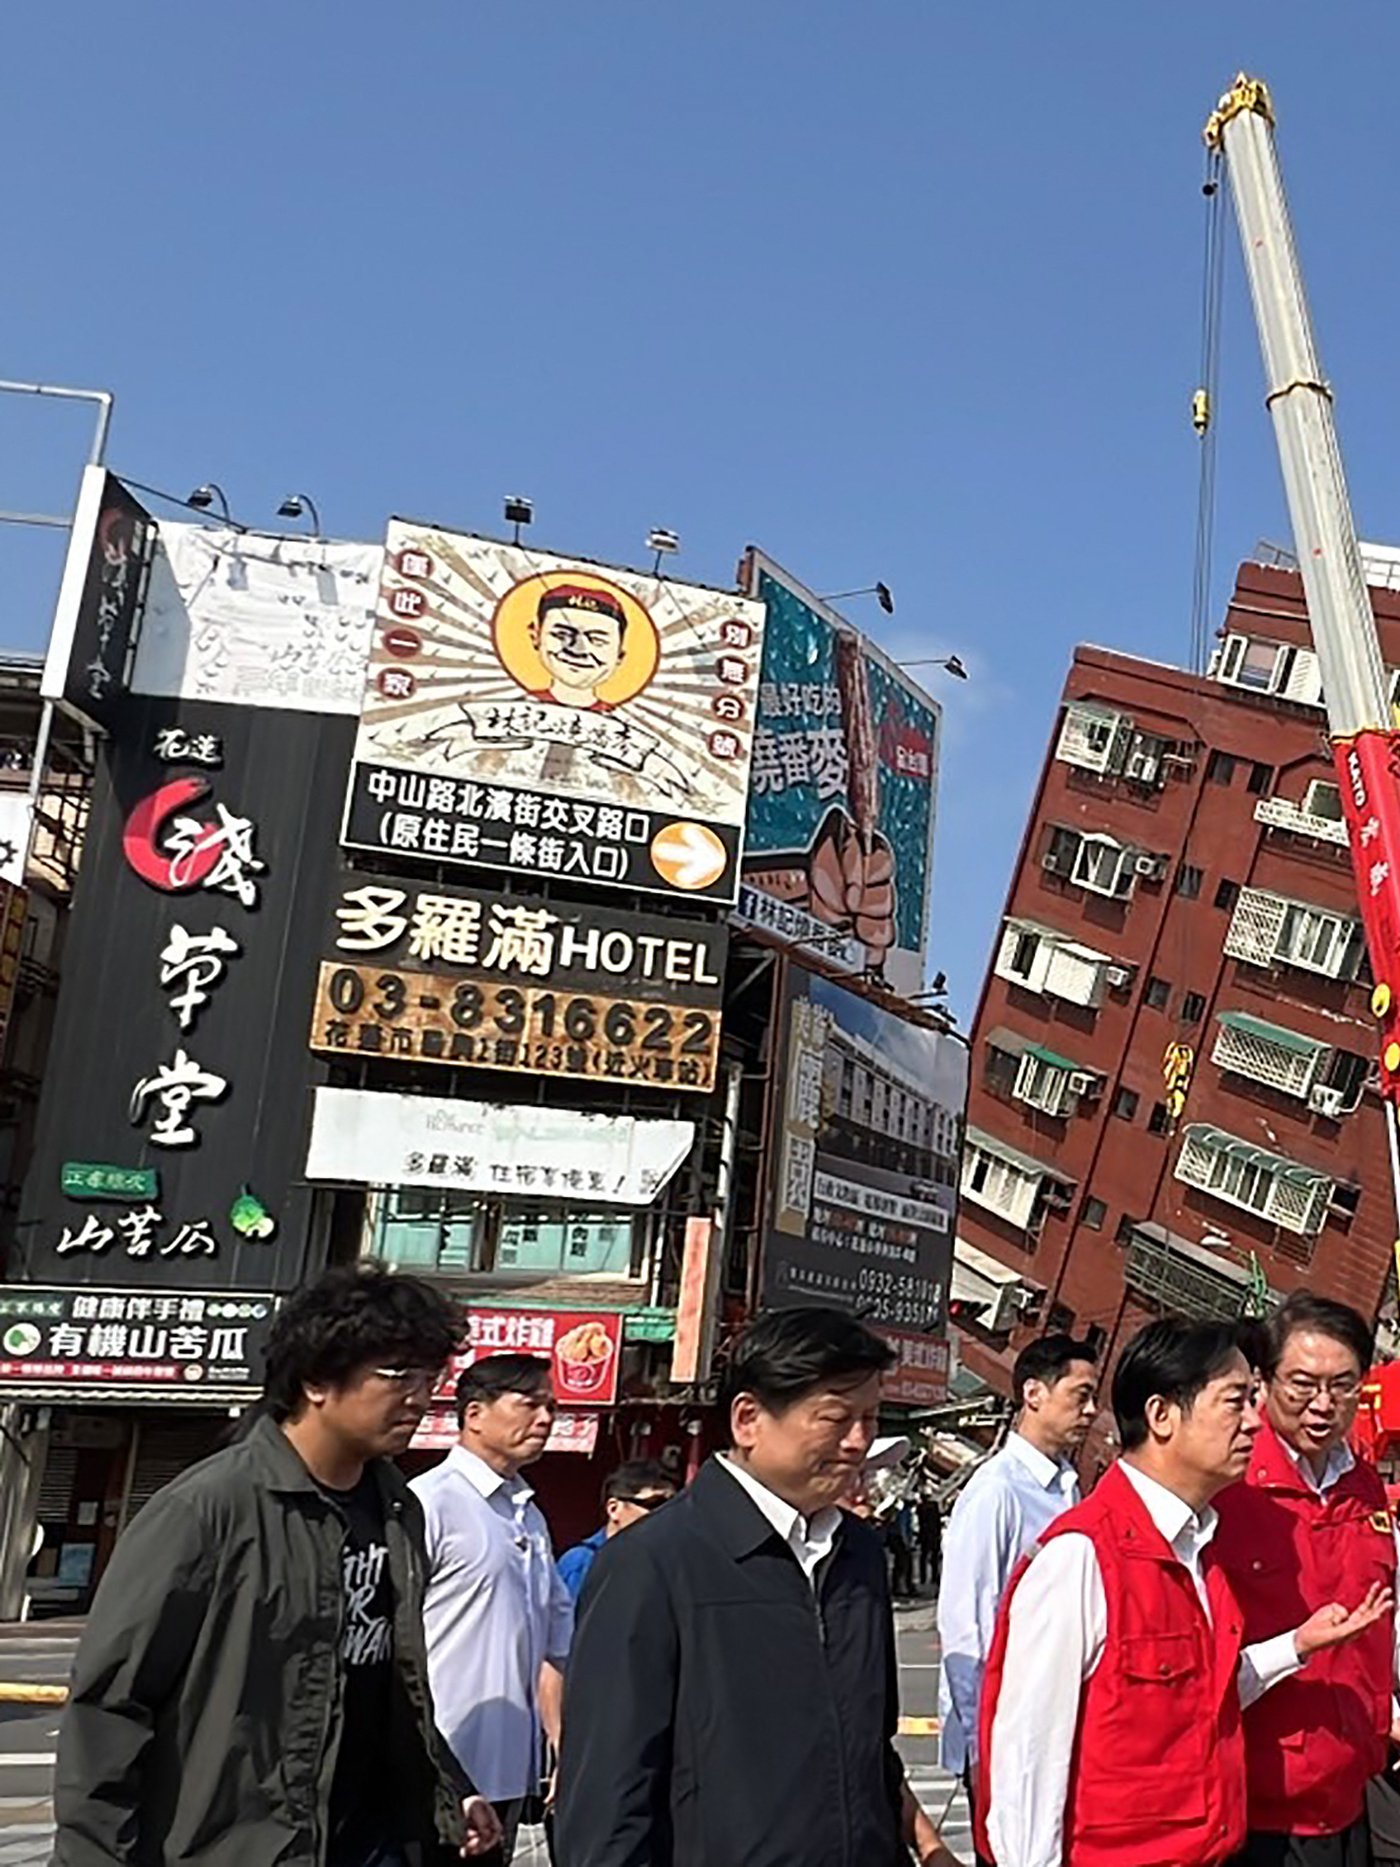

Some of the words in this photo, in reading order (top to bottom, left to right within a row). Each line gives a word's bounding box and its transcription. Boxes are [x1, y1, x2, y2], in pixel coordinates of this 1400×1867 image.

[384, 553, 430, 697] 僅此一家
[368, 768, 651, 843] 中山路北濱街交叉路口
[1348, 751, 1366, 807] KATO
[336, 886, 559, 976] 多羅滿
[559, 924, 719, 985] HOTEL
[329, 968, 714, 1056] 03-8316622
[57, 1206, 216, 1255] 山苦瓜
[73, 1295, 205, 1321] 健康伴手禮
[49, 1323, 249, 1360] 有機山苦瓜
